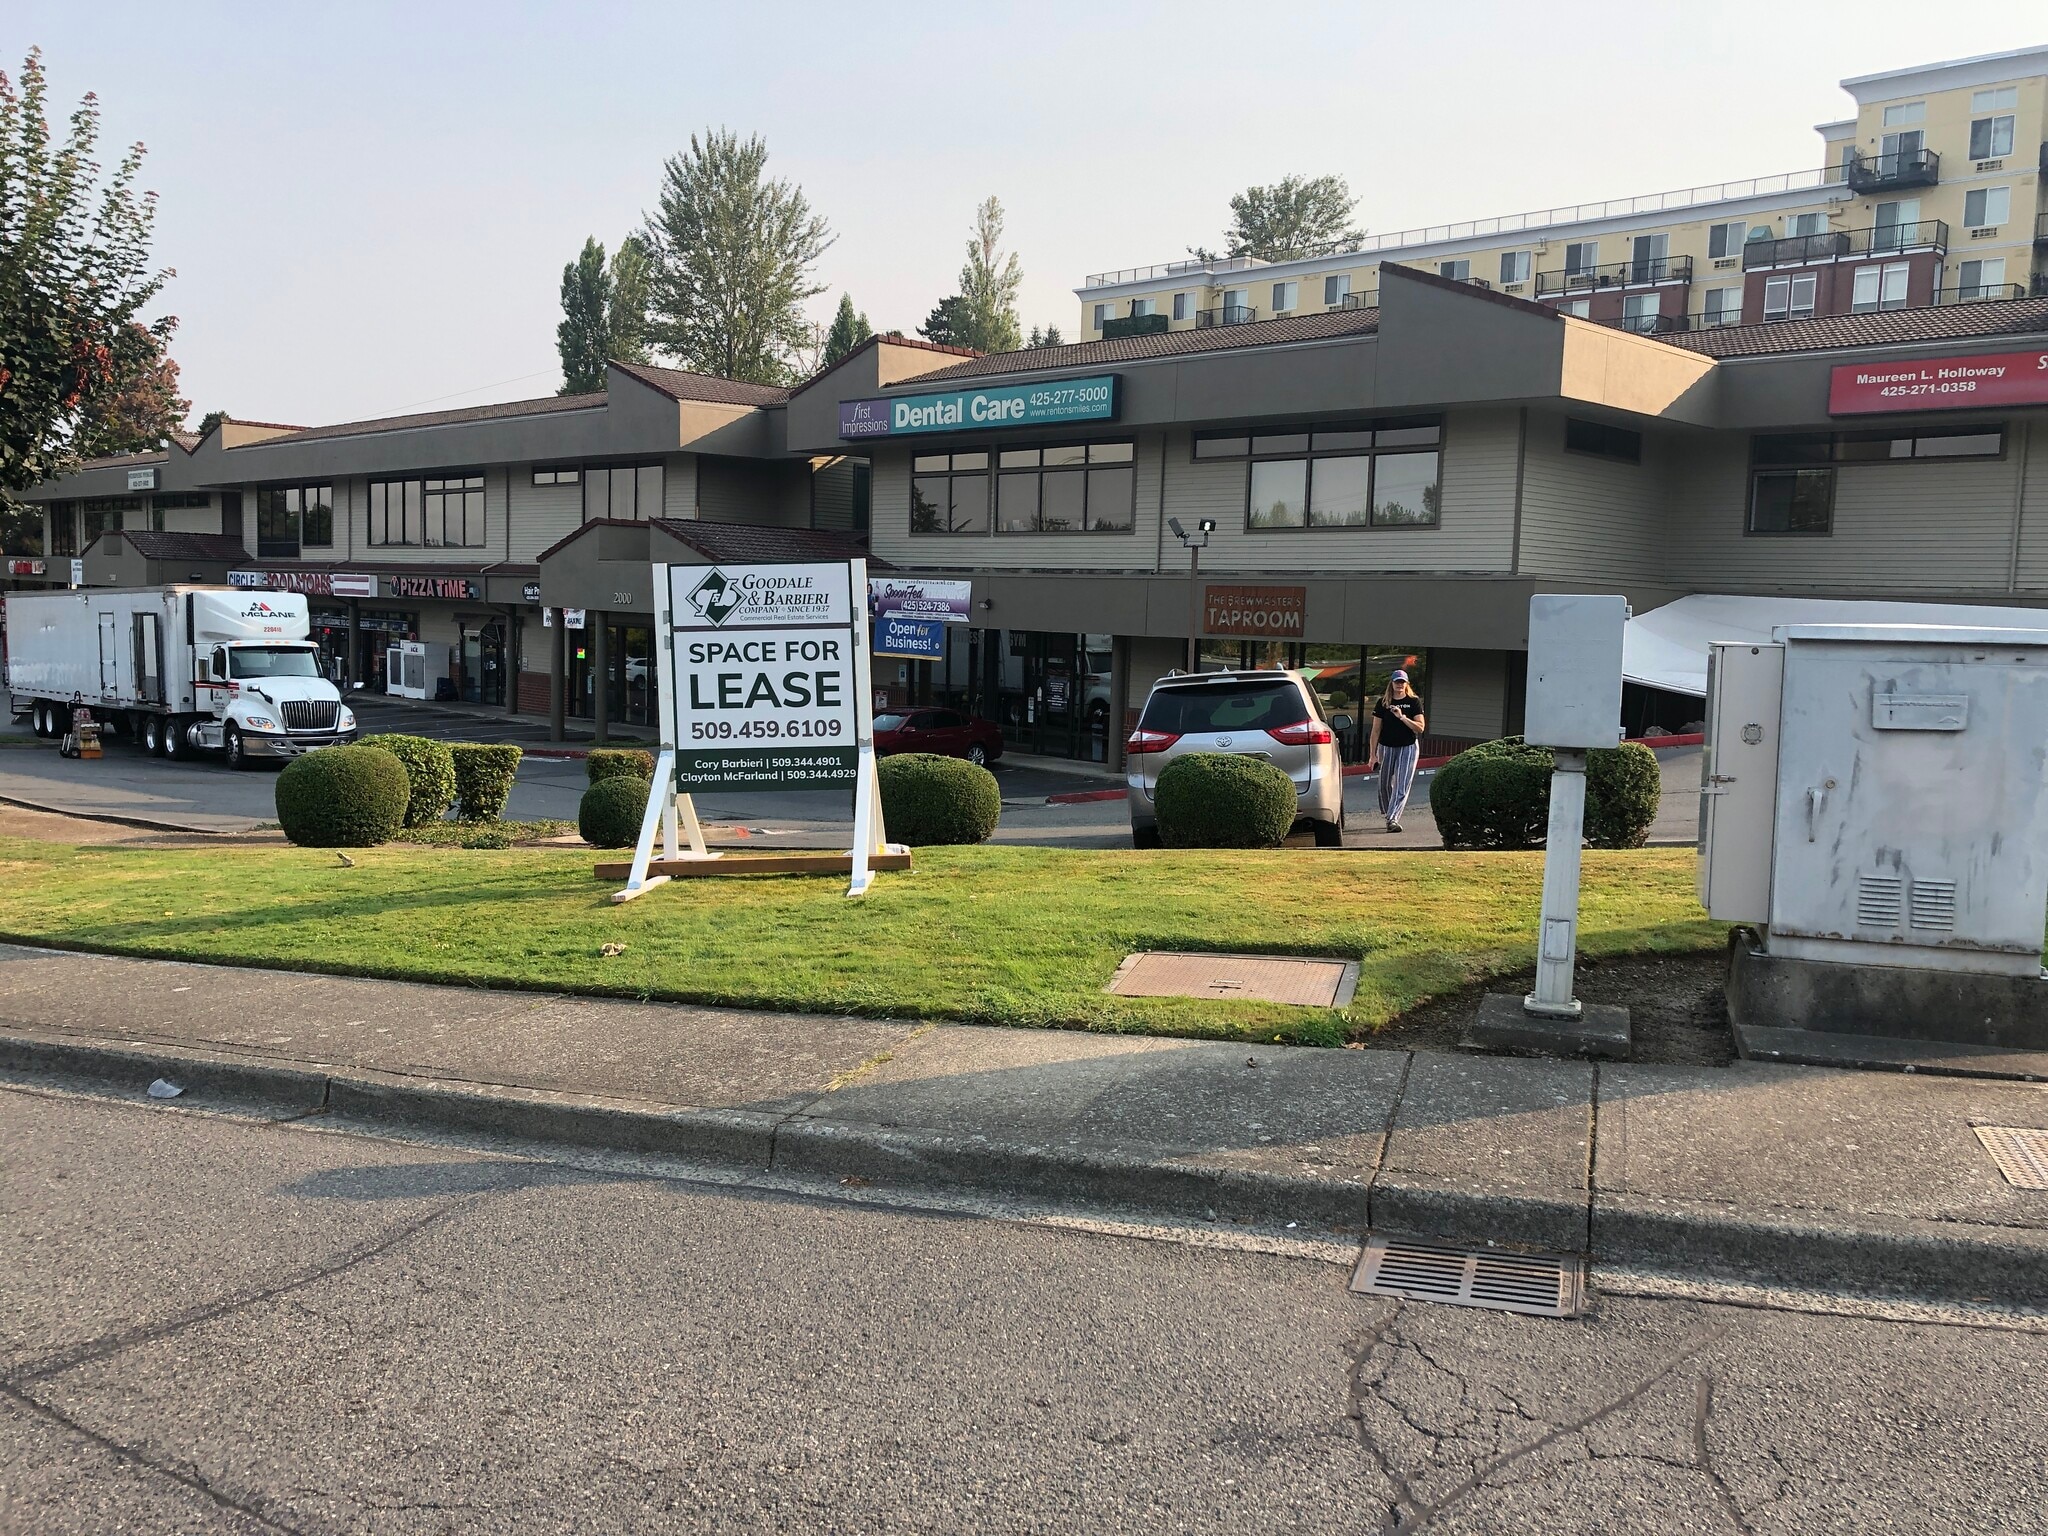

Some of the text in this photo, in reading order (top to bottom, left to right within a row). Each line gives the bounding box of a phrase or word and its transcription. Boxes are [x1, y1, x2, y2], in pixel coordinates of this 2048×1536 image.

[1857, 366, 2006, 384] Maureen L. Holloway
[1029, 386, 1108, 406] 425-277-5000
[1881, 381, 1977, 397] 425-271-0358
[852, 402, 871, 422] first
[895, 395, 1025, 428] Dental Care
[1029, 402, 1108, 418] www.rentonsmiles.com
[842, 419, 888, 436] Impressions
[613, 592, 632, 604] 2000
[747, 590, 829, 606] & BARBIERI
[1209, 594, 1224, 605] THE
[738, 606, 780, 614] COMPANY
[787, 605, 811, 613] SINCE
[1207, 607, 1300, 628] TAPROOM
[889, 622, 930, 636] Open for
[885, 636, 931, 650] Business!
[689, 640, 840, 664] SPACE FOR
[689, 671, 841, 710] LEASE
[691, 719, 842, 740] 509.459.6109
[694, 759, 719, 770] Cory
[722, 758, 763, 769] Barbieri
[772, 757, 841, 767] 509.344.4901
[680, 772, 721, 784] Clayton
[724, 770, 778, 782] McFarland
[787, 769, 856, 780] 509.344.4929
